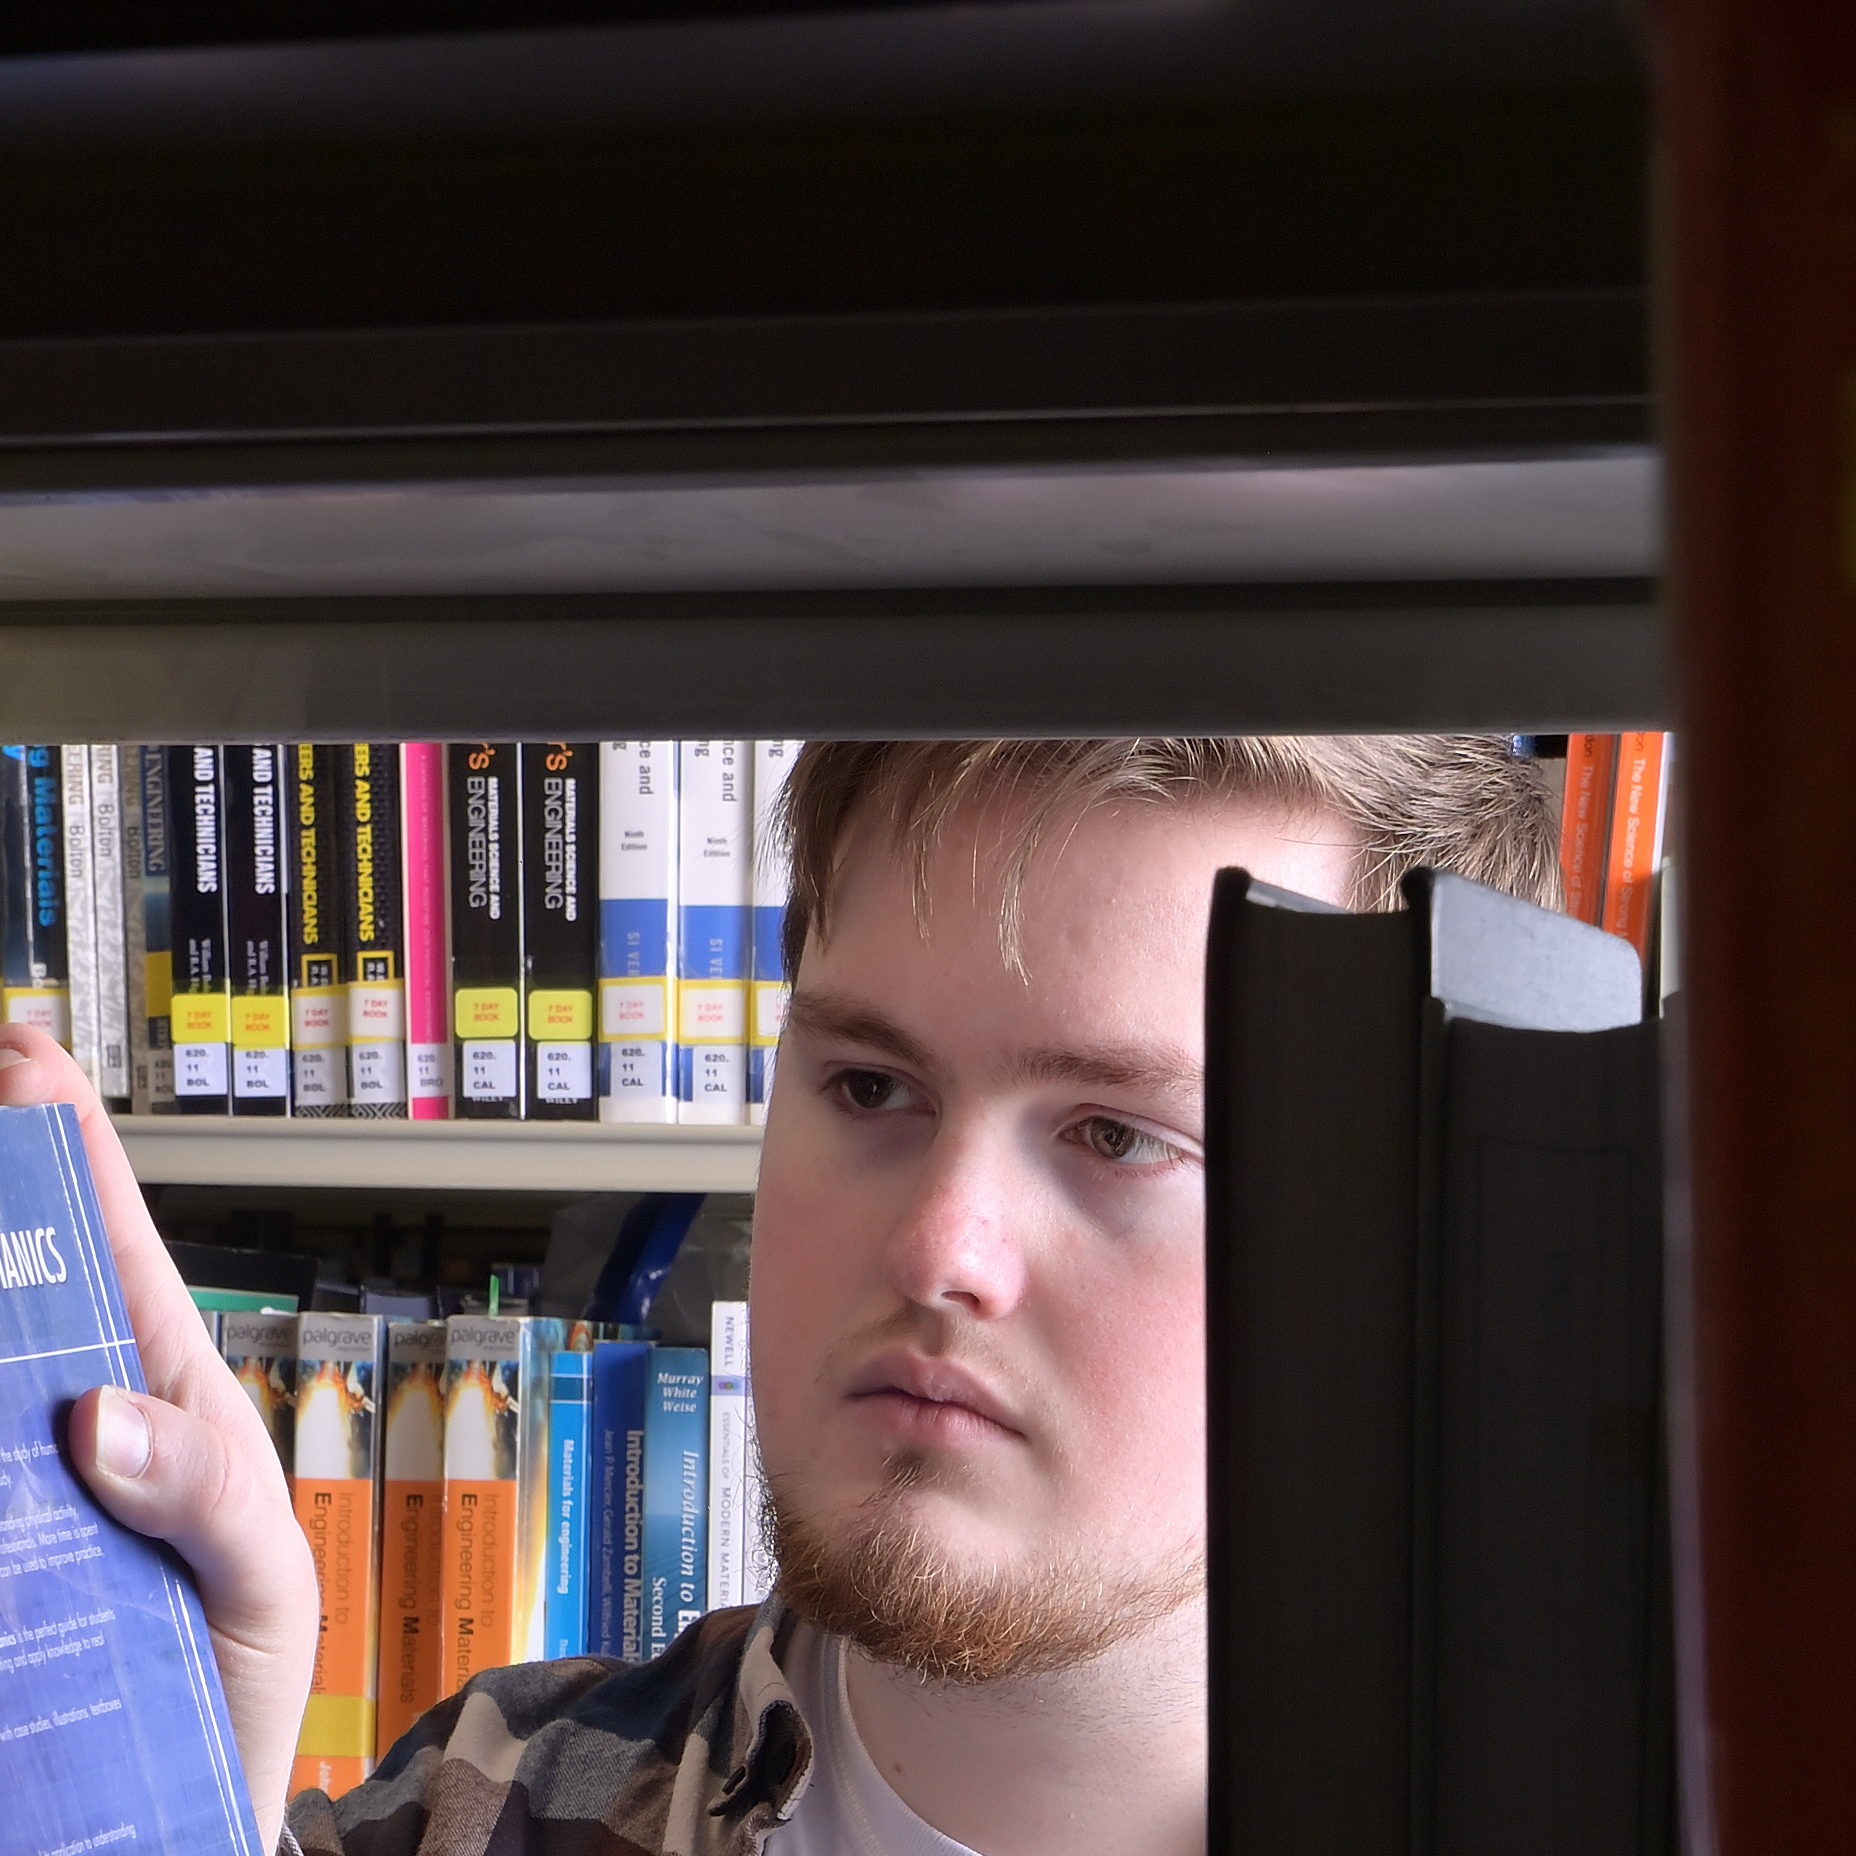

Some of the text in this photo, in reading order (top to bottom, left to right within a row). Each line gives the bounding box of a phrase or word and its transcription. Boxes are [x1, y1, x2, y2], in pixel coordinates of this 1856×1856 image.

[638, 765, 655, 796] and
[721, 772, 738, 803] and
[1631, 757, 1646, 783] The
[194, 747, 219, 894] AND TECHNICIANS
[252, 748, 277, 895] AND TECHNICIANS
[1628, 784, 1644, 815] New
[34, 776, 61, 928] Materials
[68, 823, 87, 880] Bolton
[96, 803, 116, 859] Bolton
[126, 826, 142, 880] Bolton
[466, 775, 488, 908] ENGINEERING
[544, 777, 564, 910] ENGINEERING
[564, 778, 577, 922] MATERIALS SCIENCE AND
[1622, 816, 1641, 869] Science
[299, 781, 319, 945] AND TECHNICIANS
[355, 778, 375, 942] AND TECHNICIANS
[488, 842, 501, 895] SCIENCE
[489, 895, 501, 920] AND
[186, 1078, 210, 1088] BOL
[246, 1079, 270, 1089] BOL
[303, 1083, 326, 1092] BOL
[359, 1081, 384, 1090] BOL
[473, 1067, 486, 1076] 11
[473, 1081, 496, 1091] CAL
[548, 1067, 560, 1077] 11
[548, 1082, 571, 1092] CAL
[621, 1062, 634, 1072] 11
[621, 1077, 644, 1087] CAL
[704, 1069, 717, 1078] 11
[704, 1083, 728, 1093] CAL
[302, 1326, 372, 1348] palgrave
[450, 1325, 516, 1346] palgrave
[724, 1316, 734, 1367] NEWELL
[656, 1371, 705, 1388] Murray
[661, 1386, 698, 1400] White
[661, 1400, 698, 1413] Weise
[557, 1439, 575, 1595] Materials for engineering
[623, 1429, 644, 1575] Introduction to
[678, 1450, 699, 1604] Introduction to
[720, 1487, 732, 1547] MODERN
[335, 1490, 355, 1625] Introduction to
[454, 1492, 479, 1611] Engineering
[480, 1492, 500, 1628] Introduction to
[397, 1493, 424, 1703] Engineering Materials
[650, 1577, 667, 1639] Second
